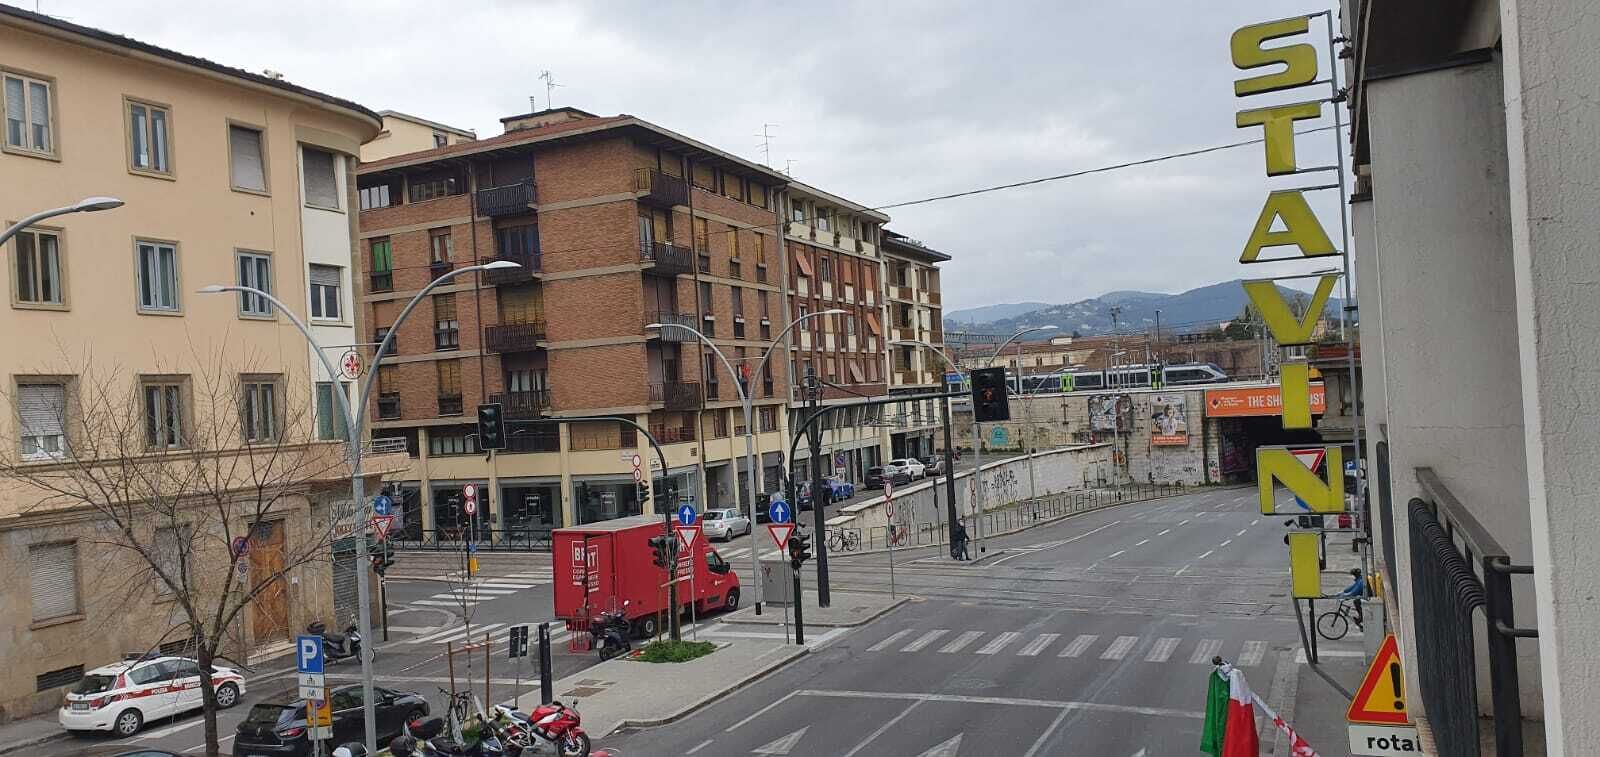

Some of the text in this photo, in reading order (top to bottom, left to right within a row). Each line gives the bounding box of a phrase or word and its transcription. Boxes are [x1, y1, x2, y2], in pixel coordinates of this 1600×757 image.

[1230, 15, 1345, 599] STAVINI
[1248, 395, 1264, 407] THE
[301, 639, 318, 669] P
